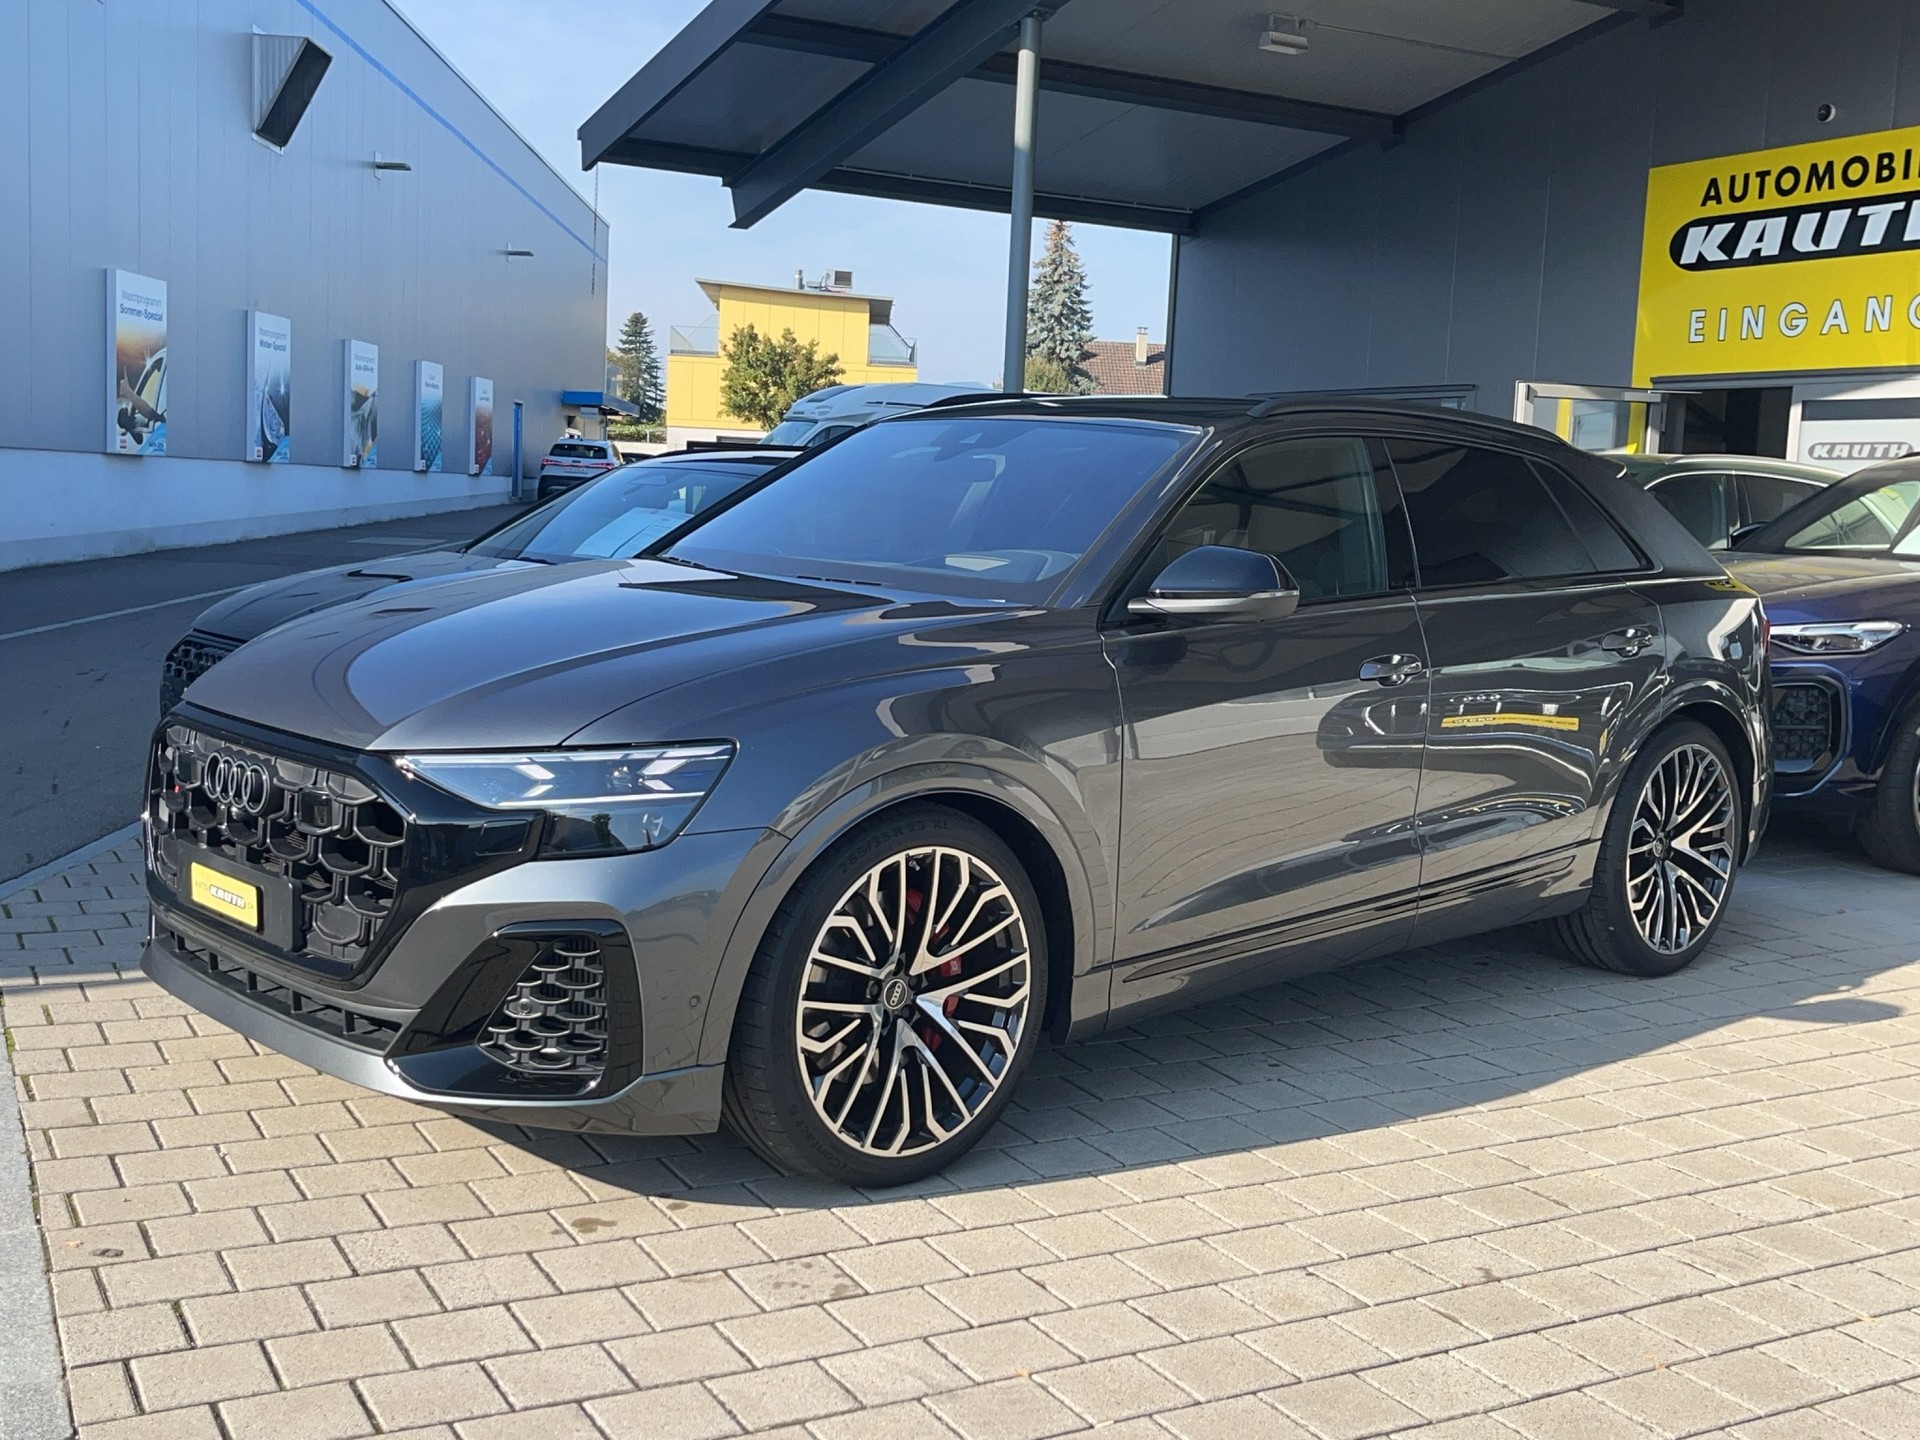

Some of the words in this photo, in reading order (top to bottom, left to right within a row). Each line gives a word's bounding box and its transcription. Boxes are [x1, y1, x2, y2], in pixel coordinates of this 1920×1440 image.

[1700, 148, 1920, 207] AUTOMOBI
[1812, 444, 1909, 458] KAUTH
[210, 885, 245, 908] KAUTH
